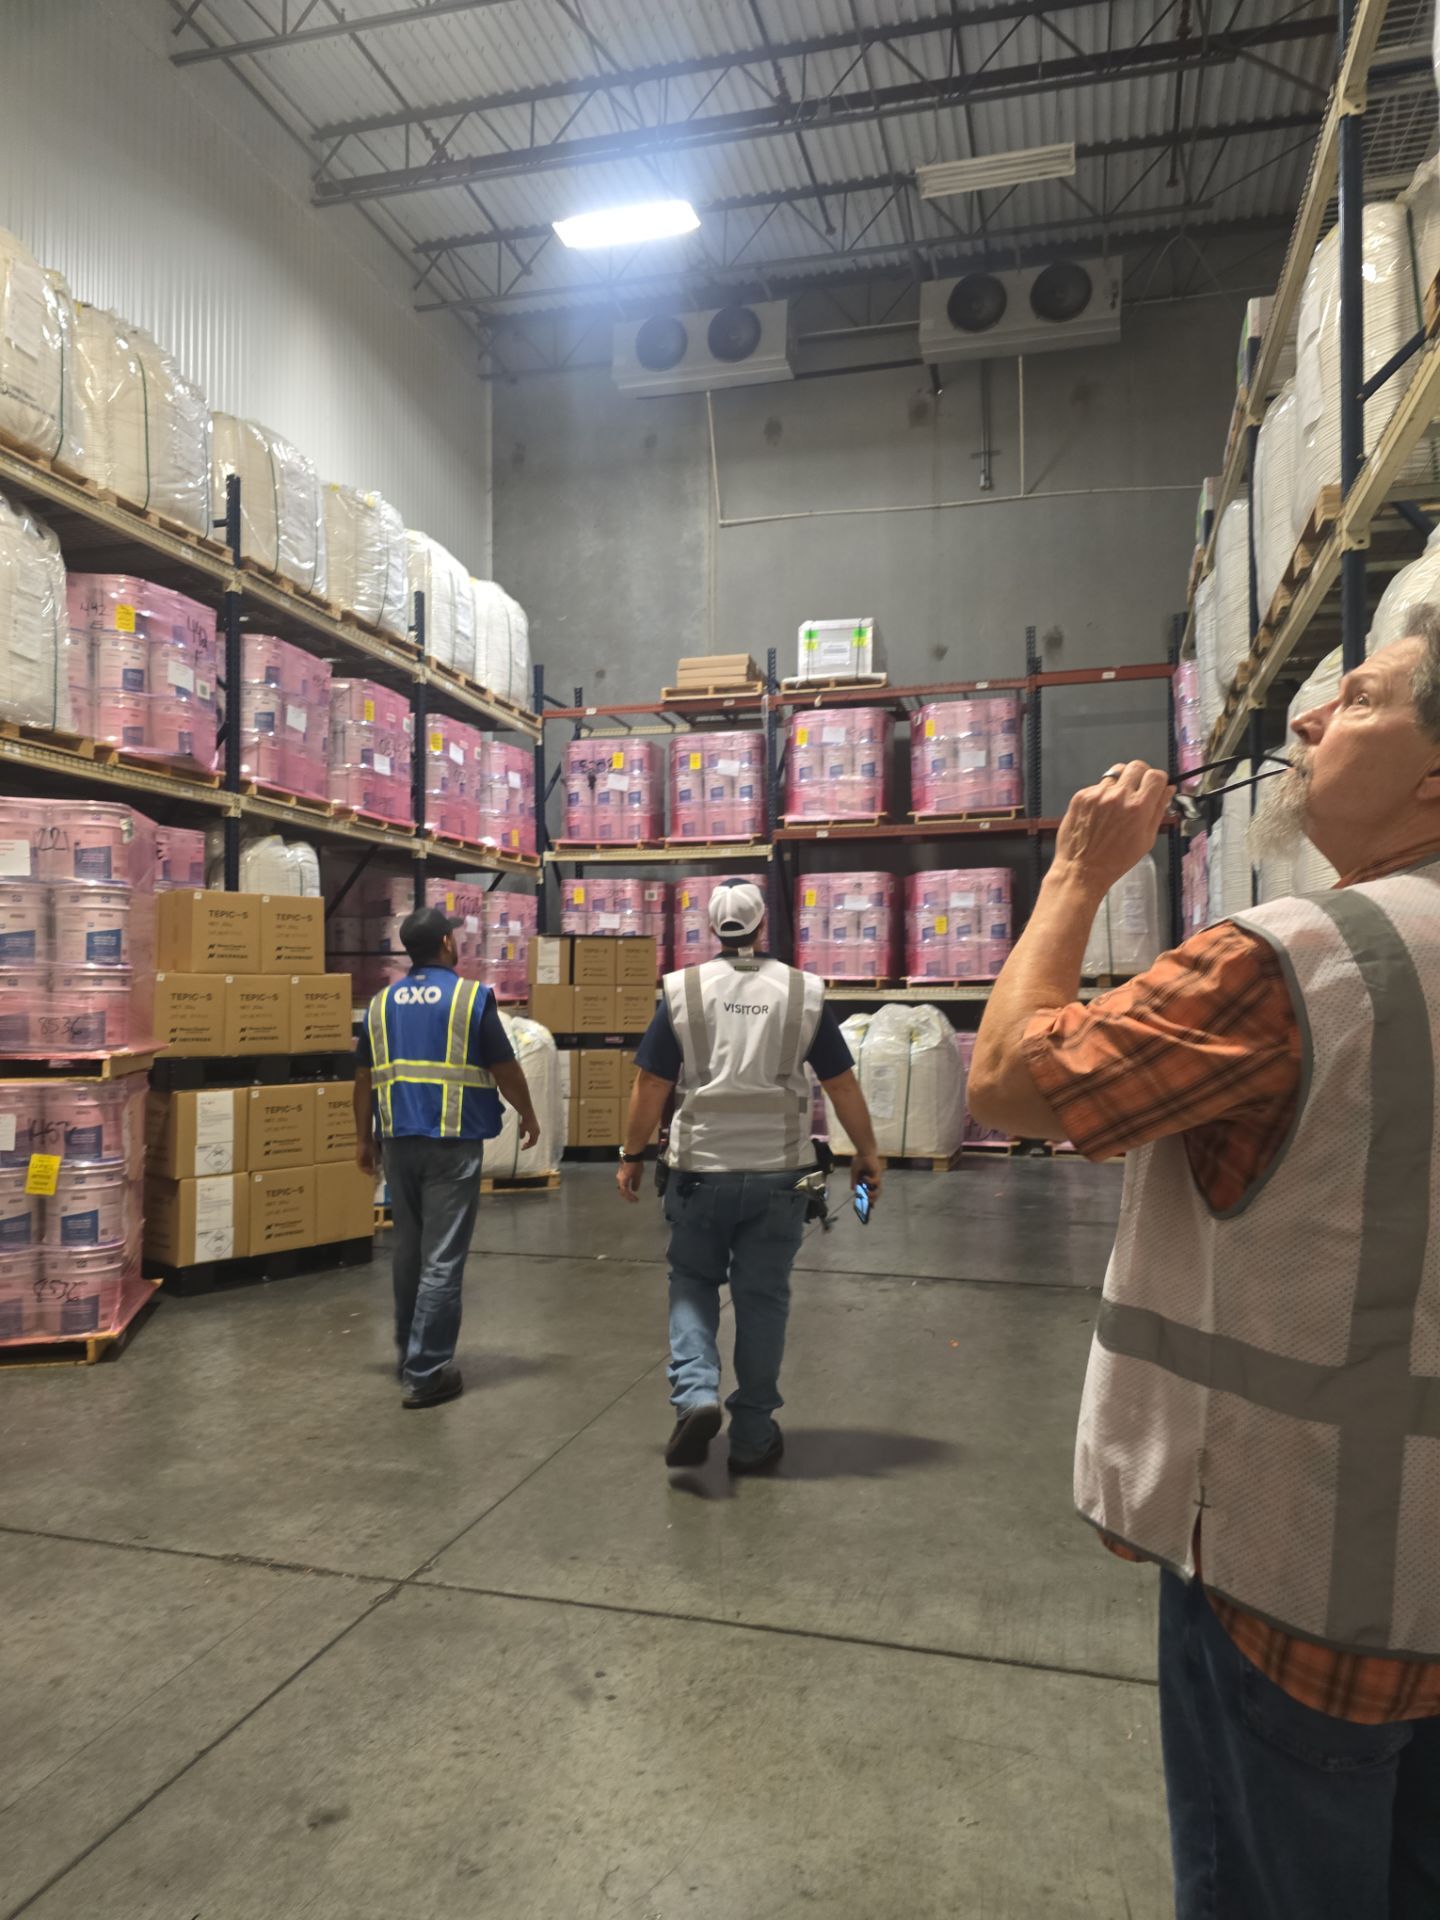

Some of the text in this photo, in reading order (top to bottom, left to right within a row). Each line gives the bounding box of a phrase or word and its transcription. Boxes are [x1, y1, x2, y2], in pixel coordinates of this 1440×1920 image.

[208, 909, 249, 920] TEPIC-S
[275, 912, 314, 922] TEPIC-S
[170, 992, 213, 1002] TEPIC-S
[239, 993, 279, 1003] TEPIC-S
[304, 992, 341, 1001] TEPIC-S
[393, 986, 442, 1005] GXO
[723, 1002, 769, 1016] VISITOR
[327, 1101, 354, 1111] TEPIC-
[265, 1185, 304, 1198] TEPIC-S
